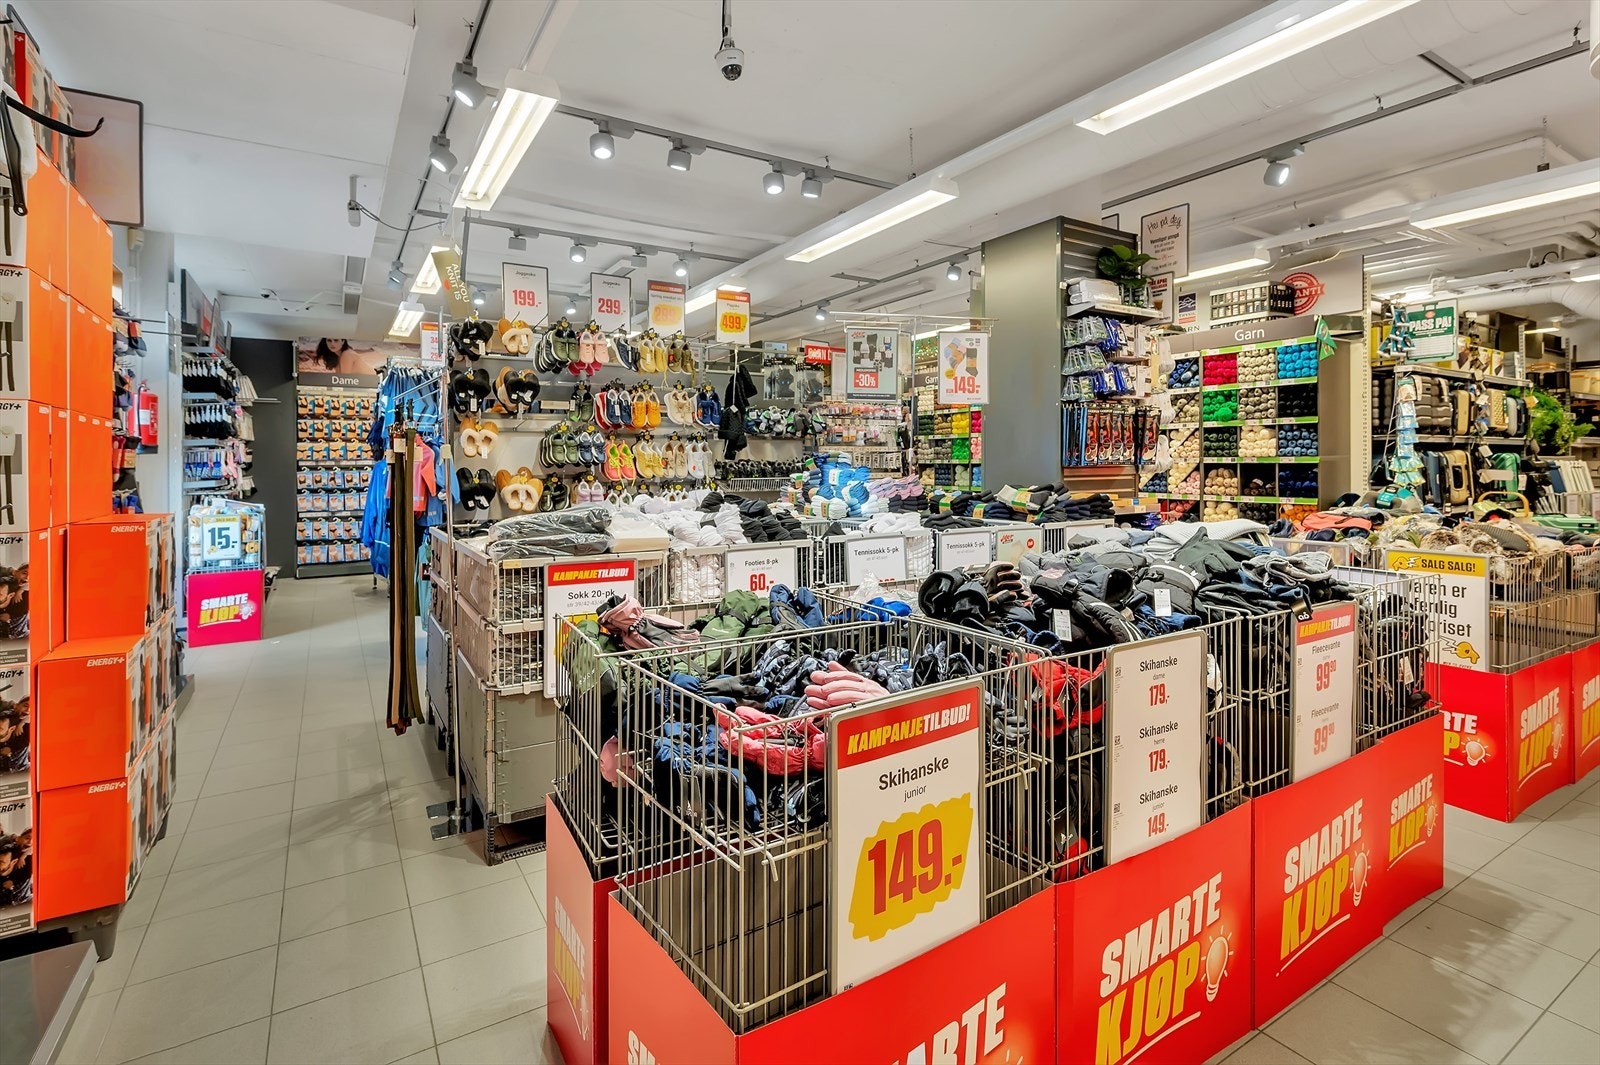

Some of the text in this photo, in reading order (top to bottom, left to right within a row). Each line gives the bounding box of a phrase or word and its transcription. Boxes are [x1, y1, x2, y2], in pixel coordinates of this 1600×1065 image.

[445, 266, 462, 301] KNIT IS
[452, 263, 470, 303] ALL YOU
[1295, 286, 1321, 298] ANTI
[1409, 319, 1434, 332] PASS
[1234, 328, 1265, 342] Garn
[331, 375, 360, 385] Dame
[855, 373, 876, 387] -30%
[110, 525, 145, 533] ENERGY+
[854, 547, 885, 556] Tennissokk
[1421, 559, 1476, 572] SALG SALG!
[567, 588, 615, 600] Sokk 20-pk
[1452, 585, 1467, 598] er
[201, 593, 248, 610] SMARTE
[1311, 641, 1341, 655] Fleecevante
[87, 656, 125, 667] ENERGY+
[1139, 656, 1177, 672] Skihanske
[1311, 702, 1339, 719] Fleecevante
[1521, 687, 1559, 739] SMARTE
[847, 703, 970, 755] KAMPANJETILBUD!
[1139, 721, 1178, 738] Skihanske
[1443, 711, 1477, 734] RTE
[878, 757, 949, 790] Skihanske
[88, 781, 127, 794] ENERGY+
[904, 785, 927, 802] junior
[1139, 783, 1178, 804] Skihanske
[1391, 773, 1432, 824] SMARTE
[1389, 805, 1424, 861] KJØP
[1284, 798, 1363, 894] SMARTE
[1280, 854, 1350, 960] KJØP
[554, 895, 585, 980] SMARTE
[1100, 872, 1222, 998] SMARTE
[1096, 941, 1201, 1065] KJØP
